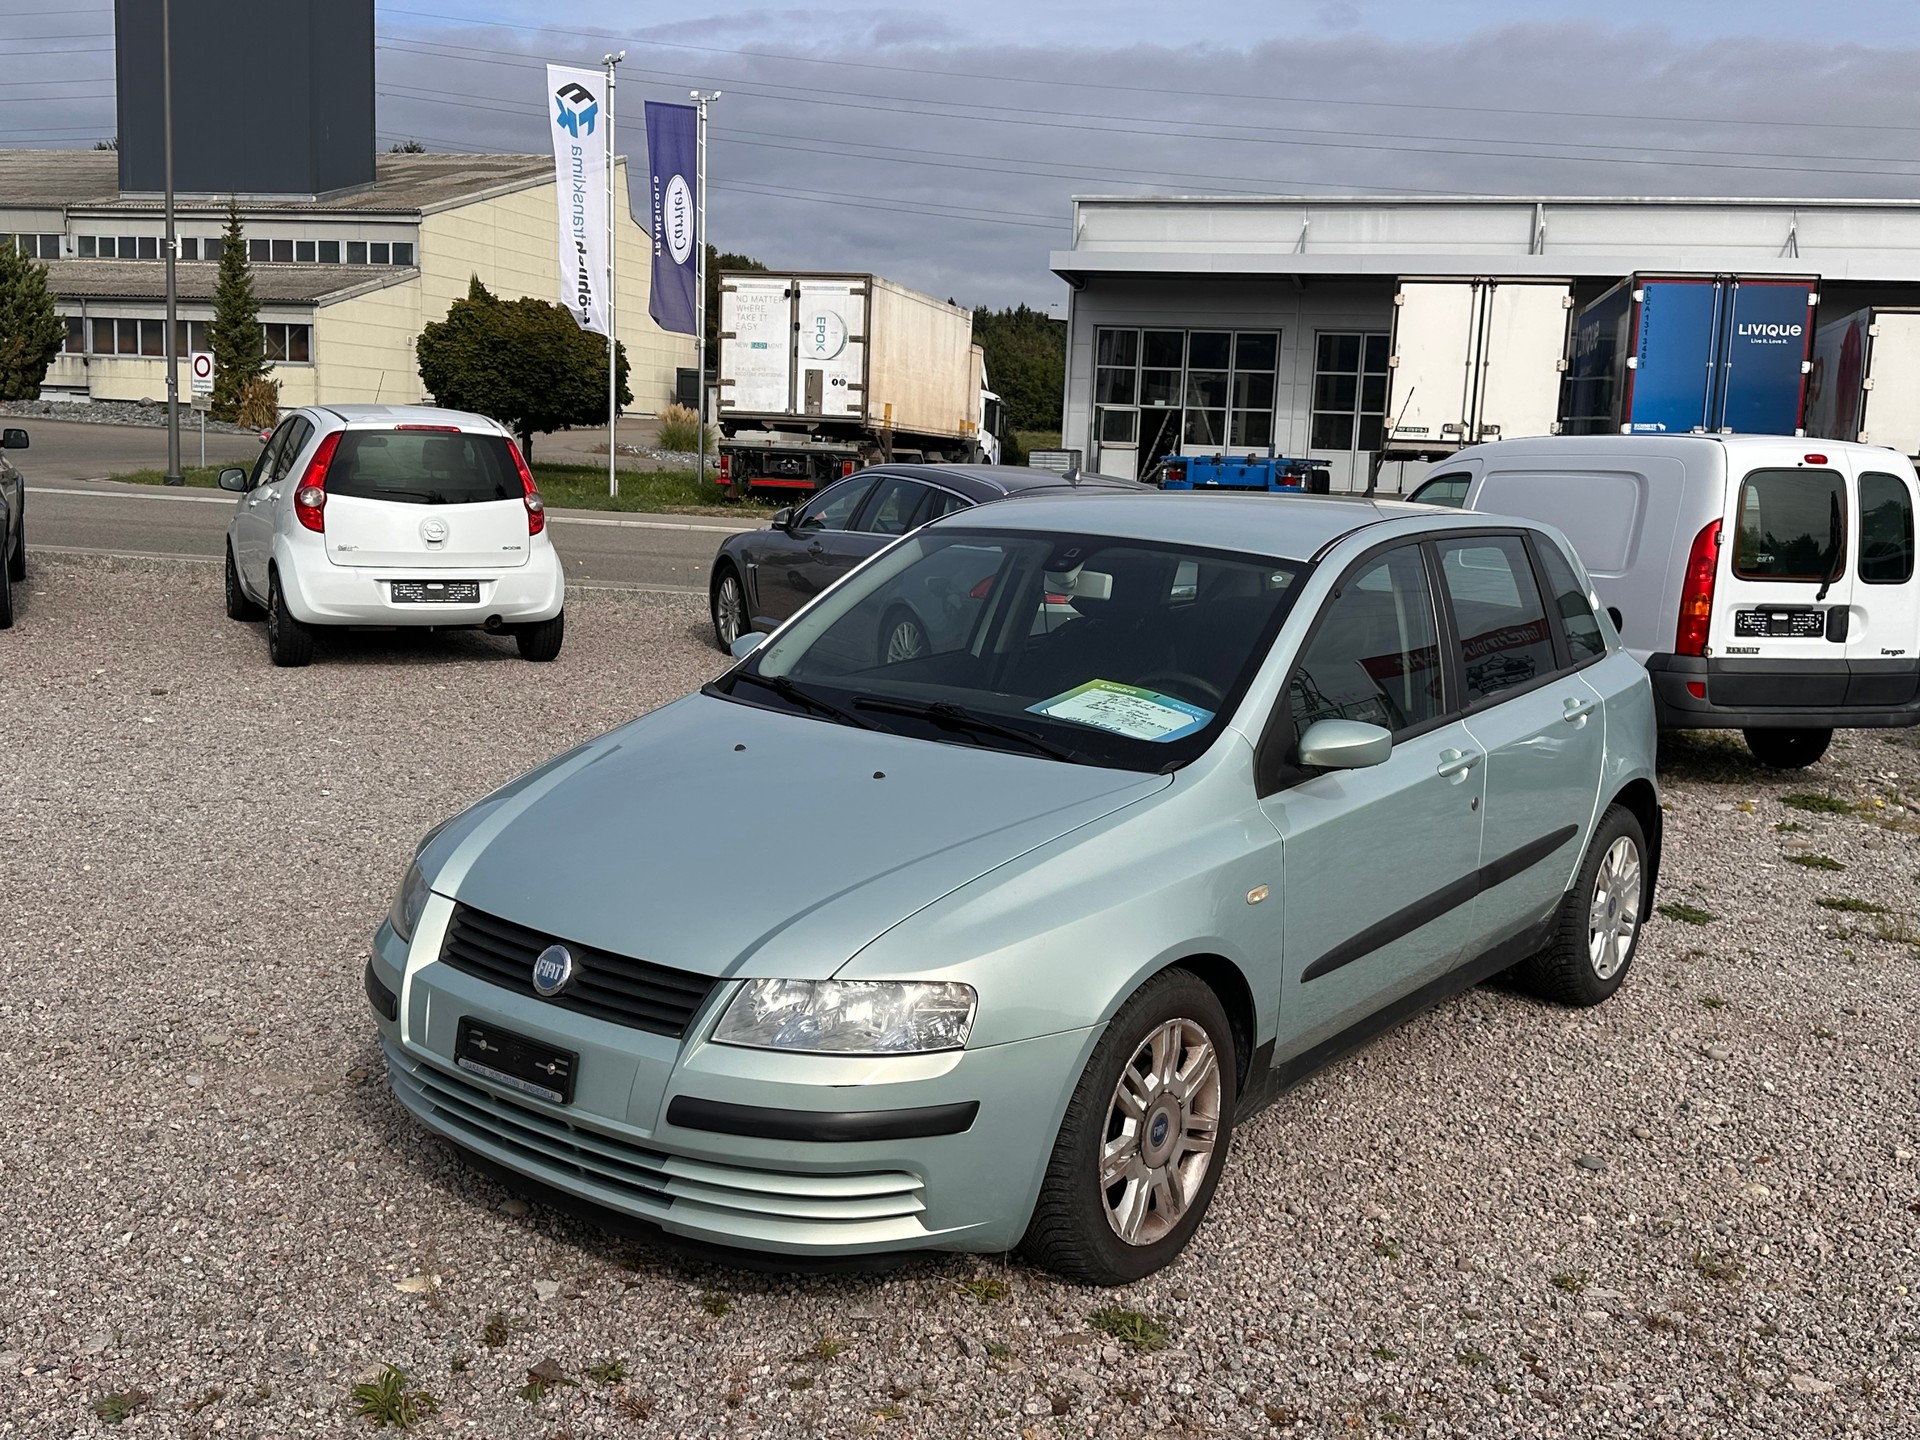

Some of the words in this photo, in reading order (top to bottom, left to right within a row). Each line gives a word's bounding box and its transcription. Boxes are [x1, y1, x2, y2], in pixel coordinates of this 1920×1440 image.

[736, 295, 748, 304] NO
[750, 295, 785, 305] MATTER
[736, 304, 766, 313] WHERE
[736, 313, 756, 322] TAKE
[759, 314, 768, 322] IT
[735, 322, 759, 331] EASY
[816, 316, 826, 352] EPOK
[537, 959, 563, 980] FIAT
